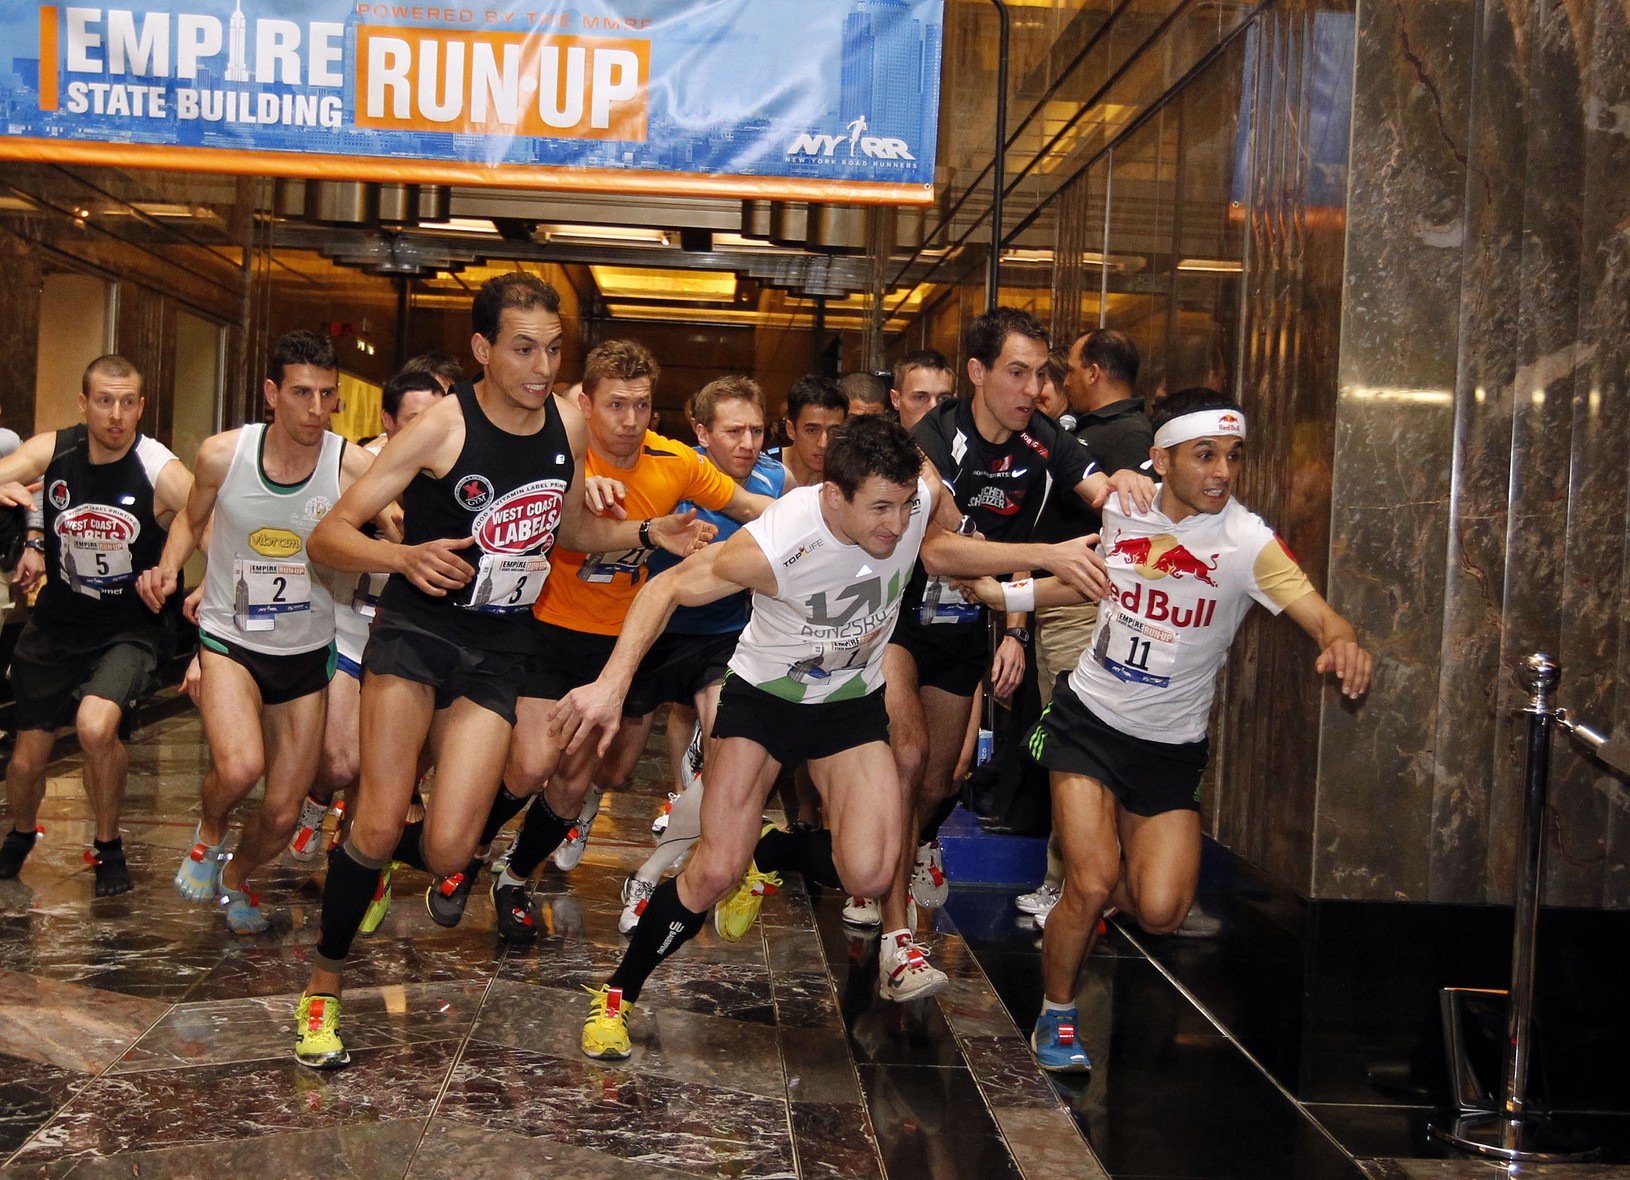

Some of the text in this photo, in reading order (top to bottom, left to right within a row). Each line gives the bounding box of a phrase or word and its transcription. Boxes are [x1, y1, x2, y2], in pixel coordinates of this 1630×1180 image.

[357, 3, 473, 22] POWERED
[485, 10, 514, 24] BY
[527, 11, 571, 28] THE
[67, 81, 343, 128] STATE BUILDING
[873, 161, 917, 169] RUNNERS
[474, 512, 488, 531] FOOD
[495, 489, 525, 506] VITAMIN
[527, 482, 548, 492] LABEL
[492, 496, 558, 525] WEST COAST
[65, 519, 89, 530] WEST
[90, 519, 118, 531] COAST
[494, 509, 557, 547] LABELS
[95, 553, 110, 575] 5
[503, 560, 527, 568] EMPIRE
[272, 576, 287, 602] 2
[509, 576, 527, 604] 3
[1110, 582, 1217, 628] ed Bull
[1119, 612, 1144, 630] EMPIRE
[1124, 636, 1151, 671] 11
